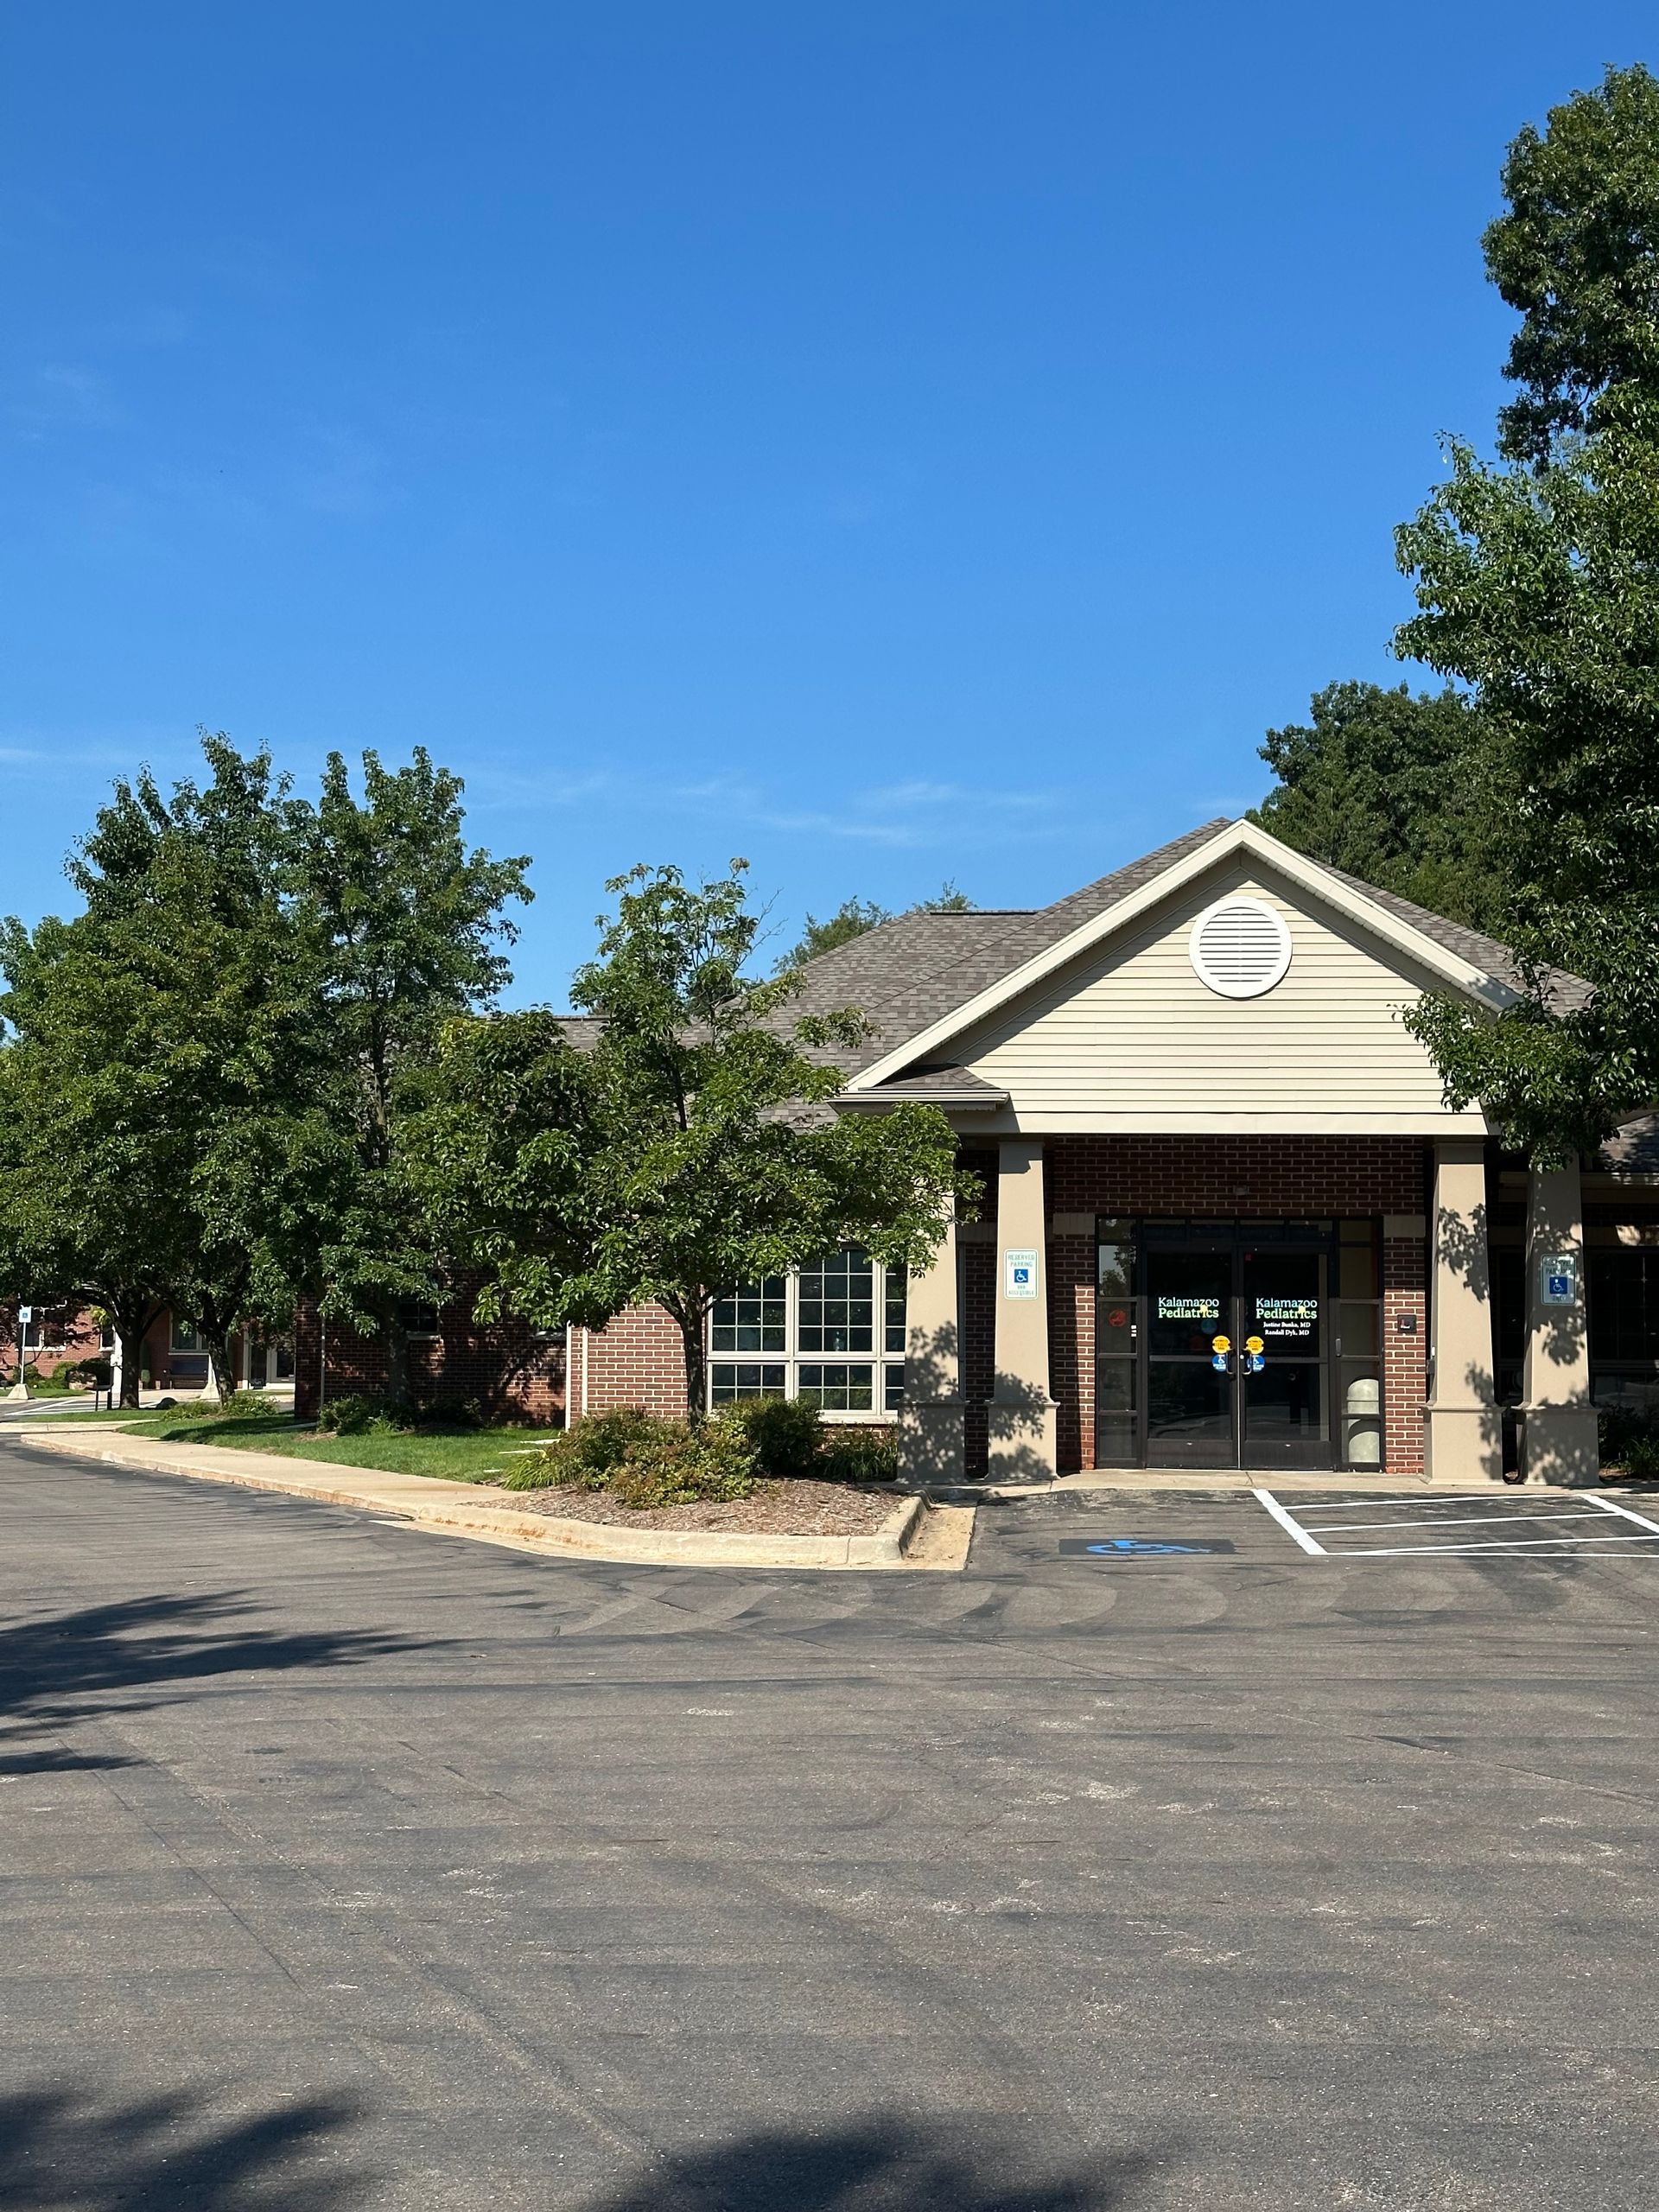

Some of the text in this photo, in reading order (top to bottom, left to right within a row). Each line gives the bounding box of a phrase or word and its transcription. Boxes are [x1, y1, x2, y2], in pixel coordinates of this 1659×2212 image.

[1158, 1297, 1219, 1307] Kalamazoo
[1255, 1298, 1318, 1308] Kalamazoo
[1158, 1307, 1219, 1319] Pediatrics
[1255, 1308, 1318, 1319] Pediatrics
